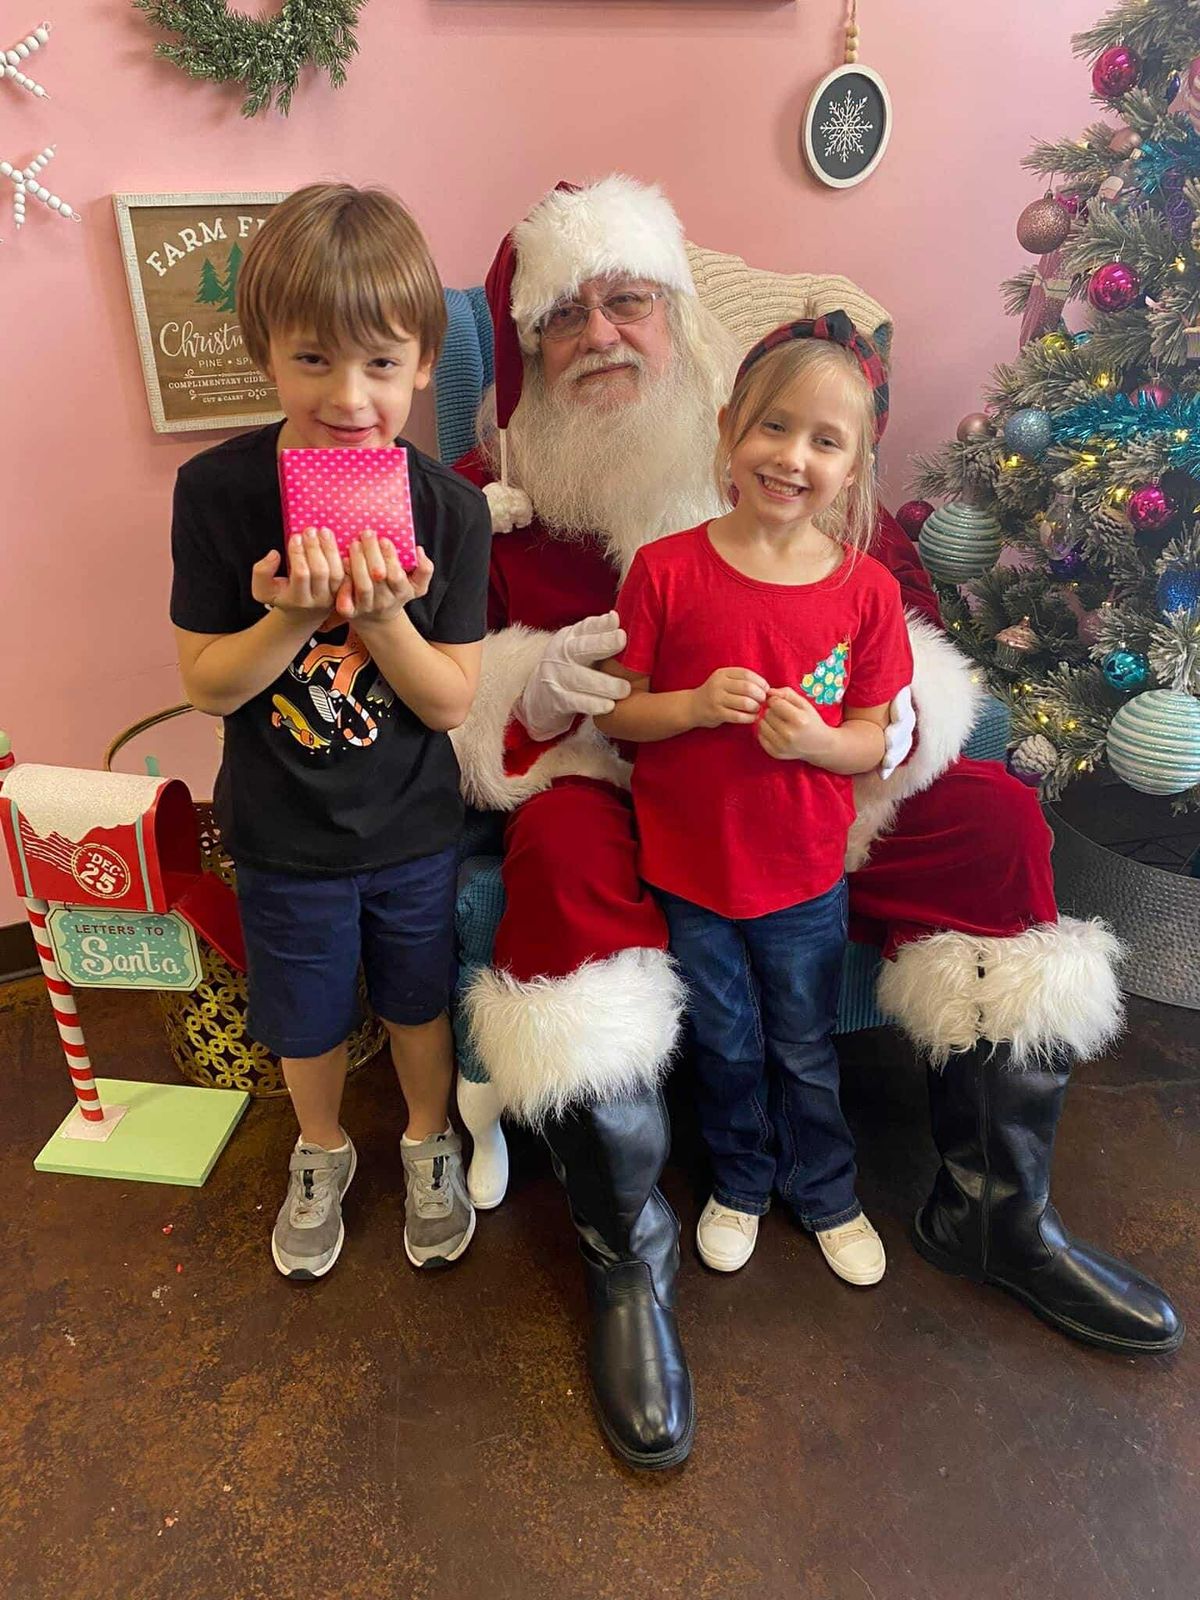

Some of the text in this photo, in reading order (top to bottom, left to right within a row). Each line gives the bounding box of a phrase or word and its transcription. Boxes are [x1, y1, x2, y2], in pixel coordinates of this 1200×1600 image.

[146, 217, 227, 277] FARM
[199, 359, 223, 368] PINE
[168, 377, 241, 390] COMPLIMENTARY
[79, 863, 117, 894] 25
[75, 925, 164, 936] LETTERS TO
[80, 936, 181, 976] Santa
